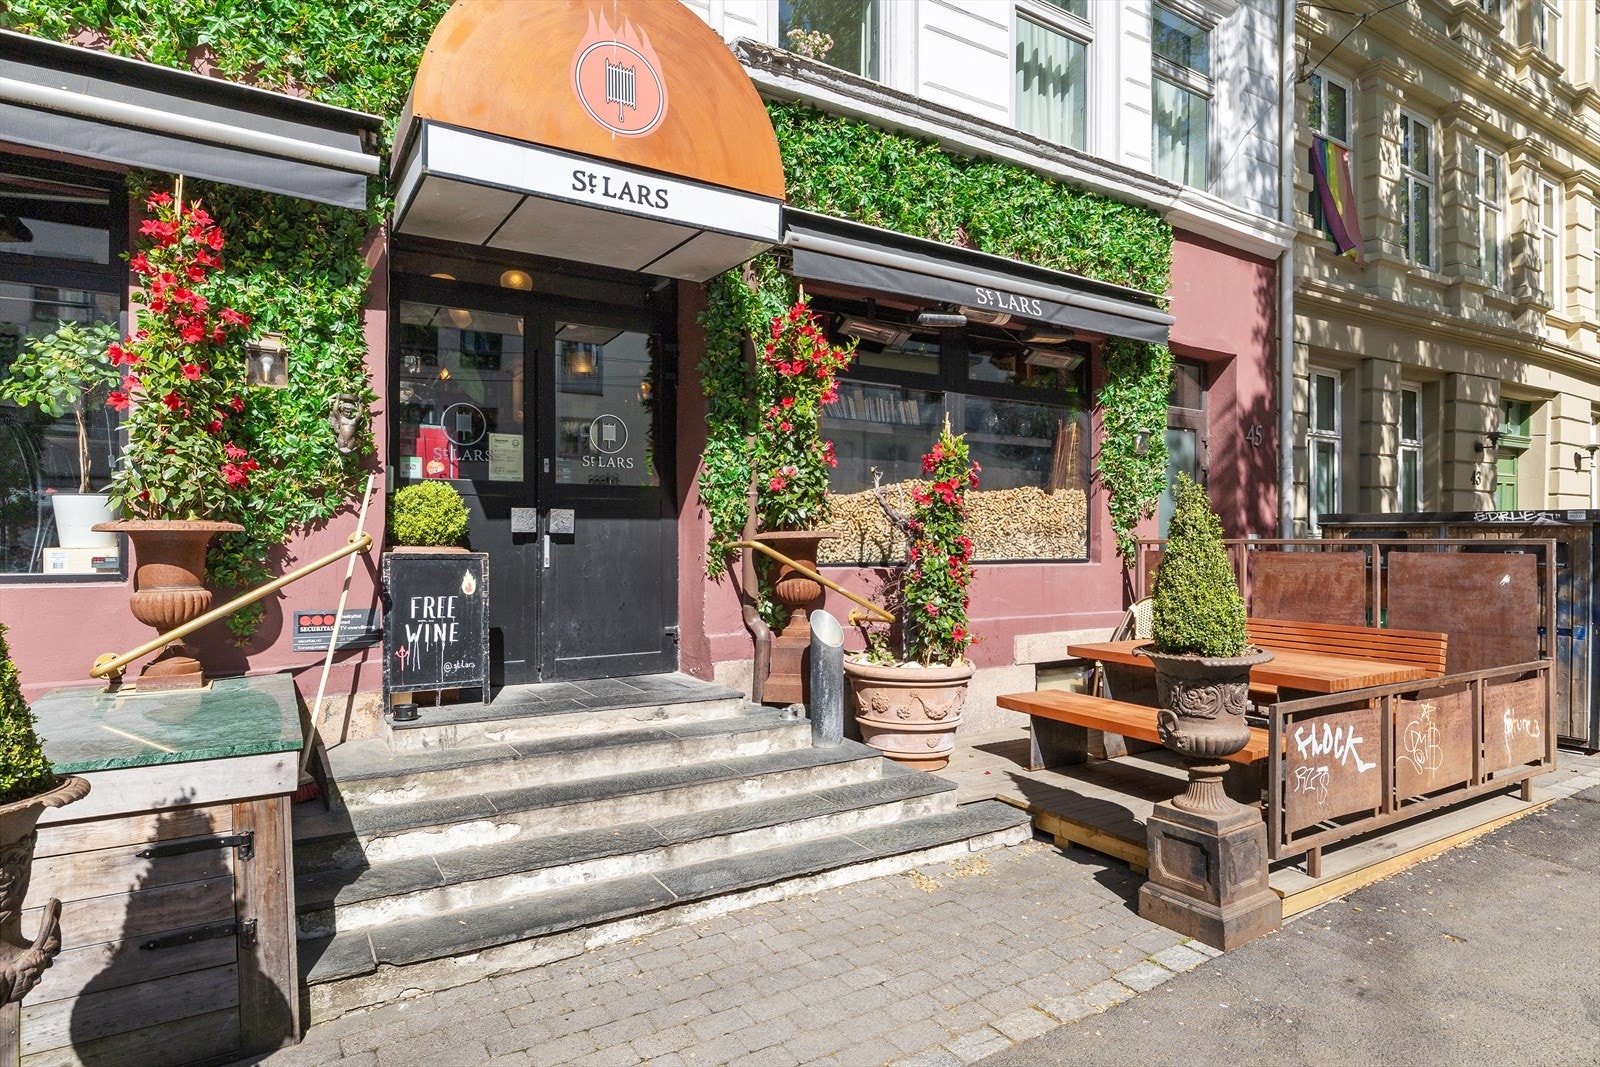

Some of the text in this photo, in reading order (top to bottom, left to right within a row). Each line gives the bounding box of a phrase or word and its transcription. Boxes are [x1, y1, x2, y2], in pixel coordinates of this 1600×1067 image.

[602, 176, 669, 209] LARS
[995, 291, 1042, 316] LARS
[1246, 424, 1263, 448] 45
[453, 448, 494, 462] LARS
[598, 456, 634, 469] LARS
[410, 595, 459, 619] FREE
[300, 625, 335, 633] SECURITAS
[405, 622, 460, 643] WINE
[1294, 722, 1377, 773] FLOCK
